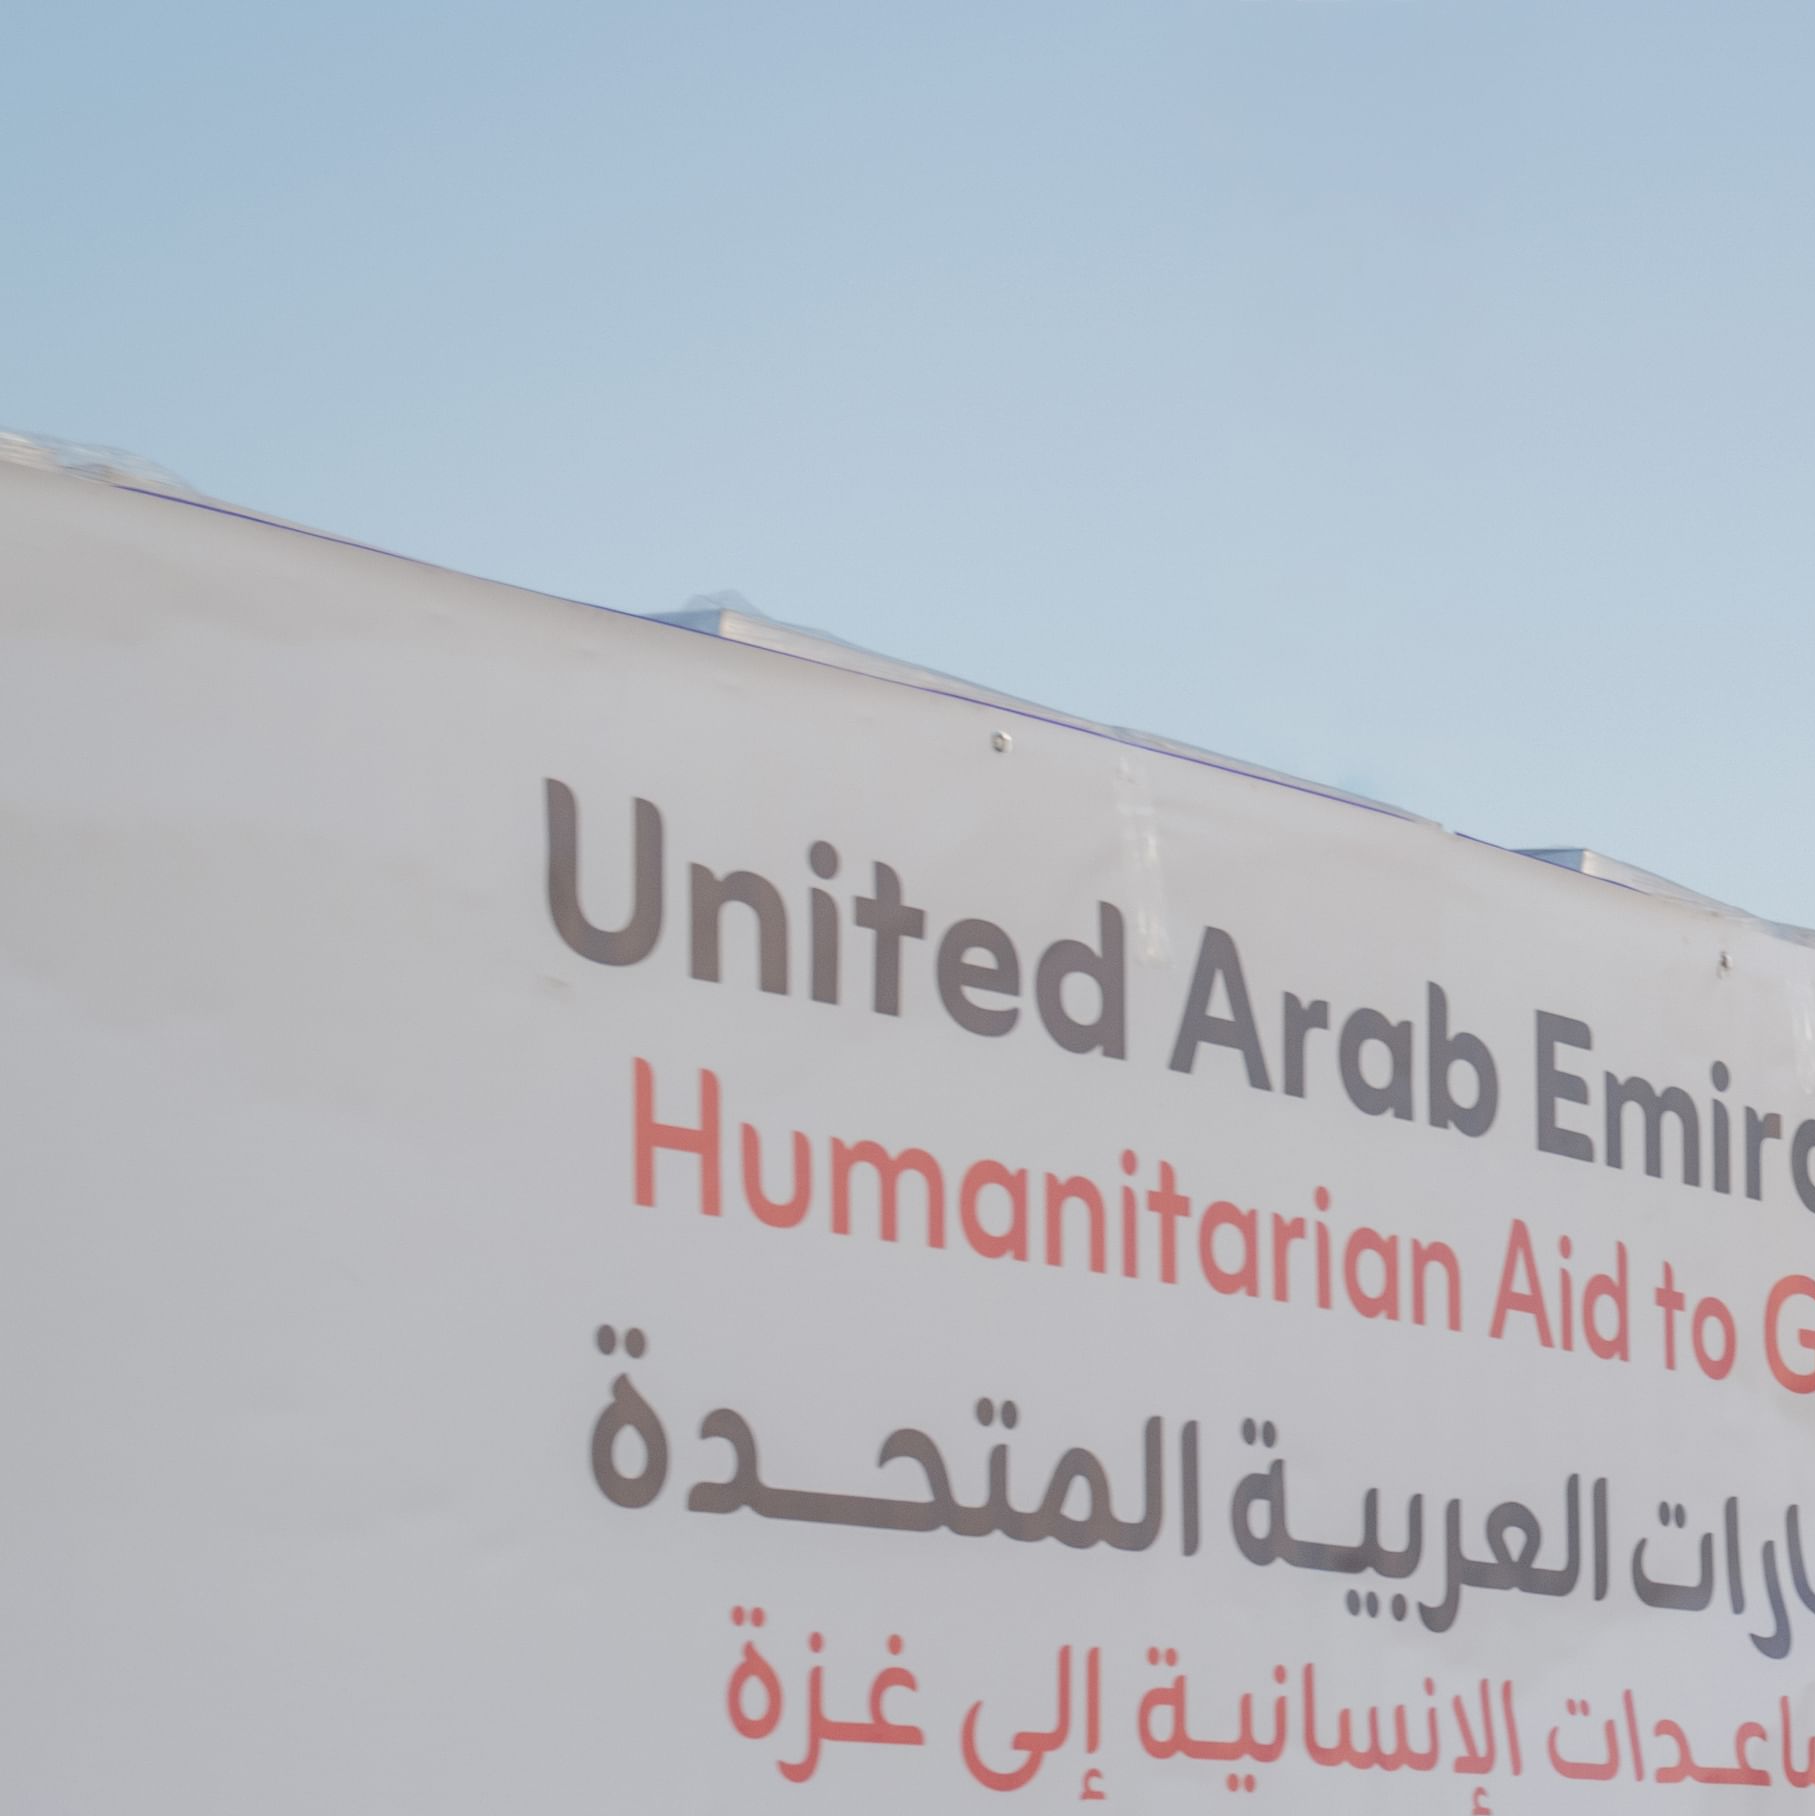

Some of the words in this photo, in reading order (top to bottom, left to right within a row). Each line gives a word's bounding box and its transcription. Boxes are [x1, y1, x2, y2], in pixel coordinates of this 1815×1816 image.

[545, 778, 1127, 1061] United
[1168, 926, 1500, 1139] Arab
[633, 1056, 1462, 1332] Humanitarian
[1490, 1219, 1629, 1362] Aid
[1654, 1262, 1737, 1381] to
[589, 1324, 1200, 1557] المتحدة
[1230, 1417, 1610, 1635] العربية
[726, 1605, 926, 1784] غزة
[960, 1645, 1107, 1802] إلى
[1137, 1646, 1523, 1816] الإنسانية
